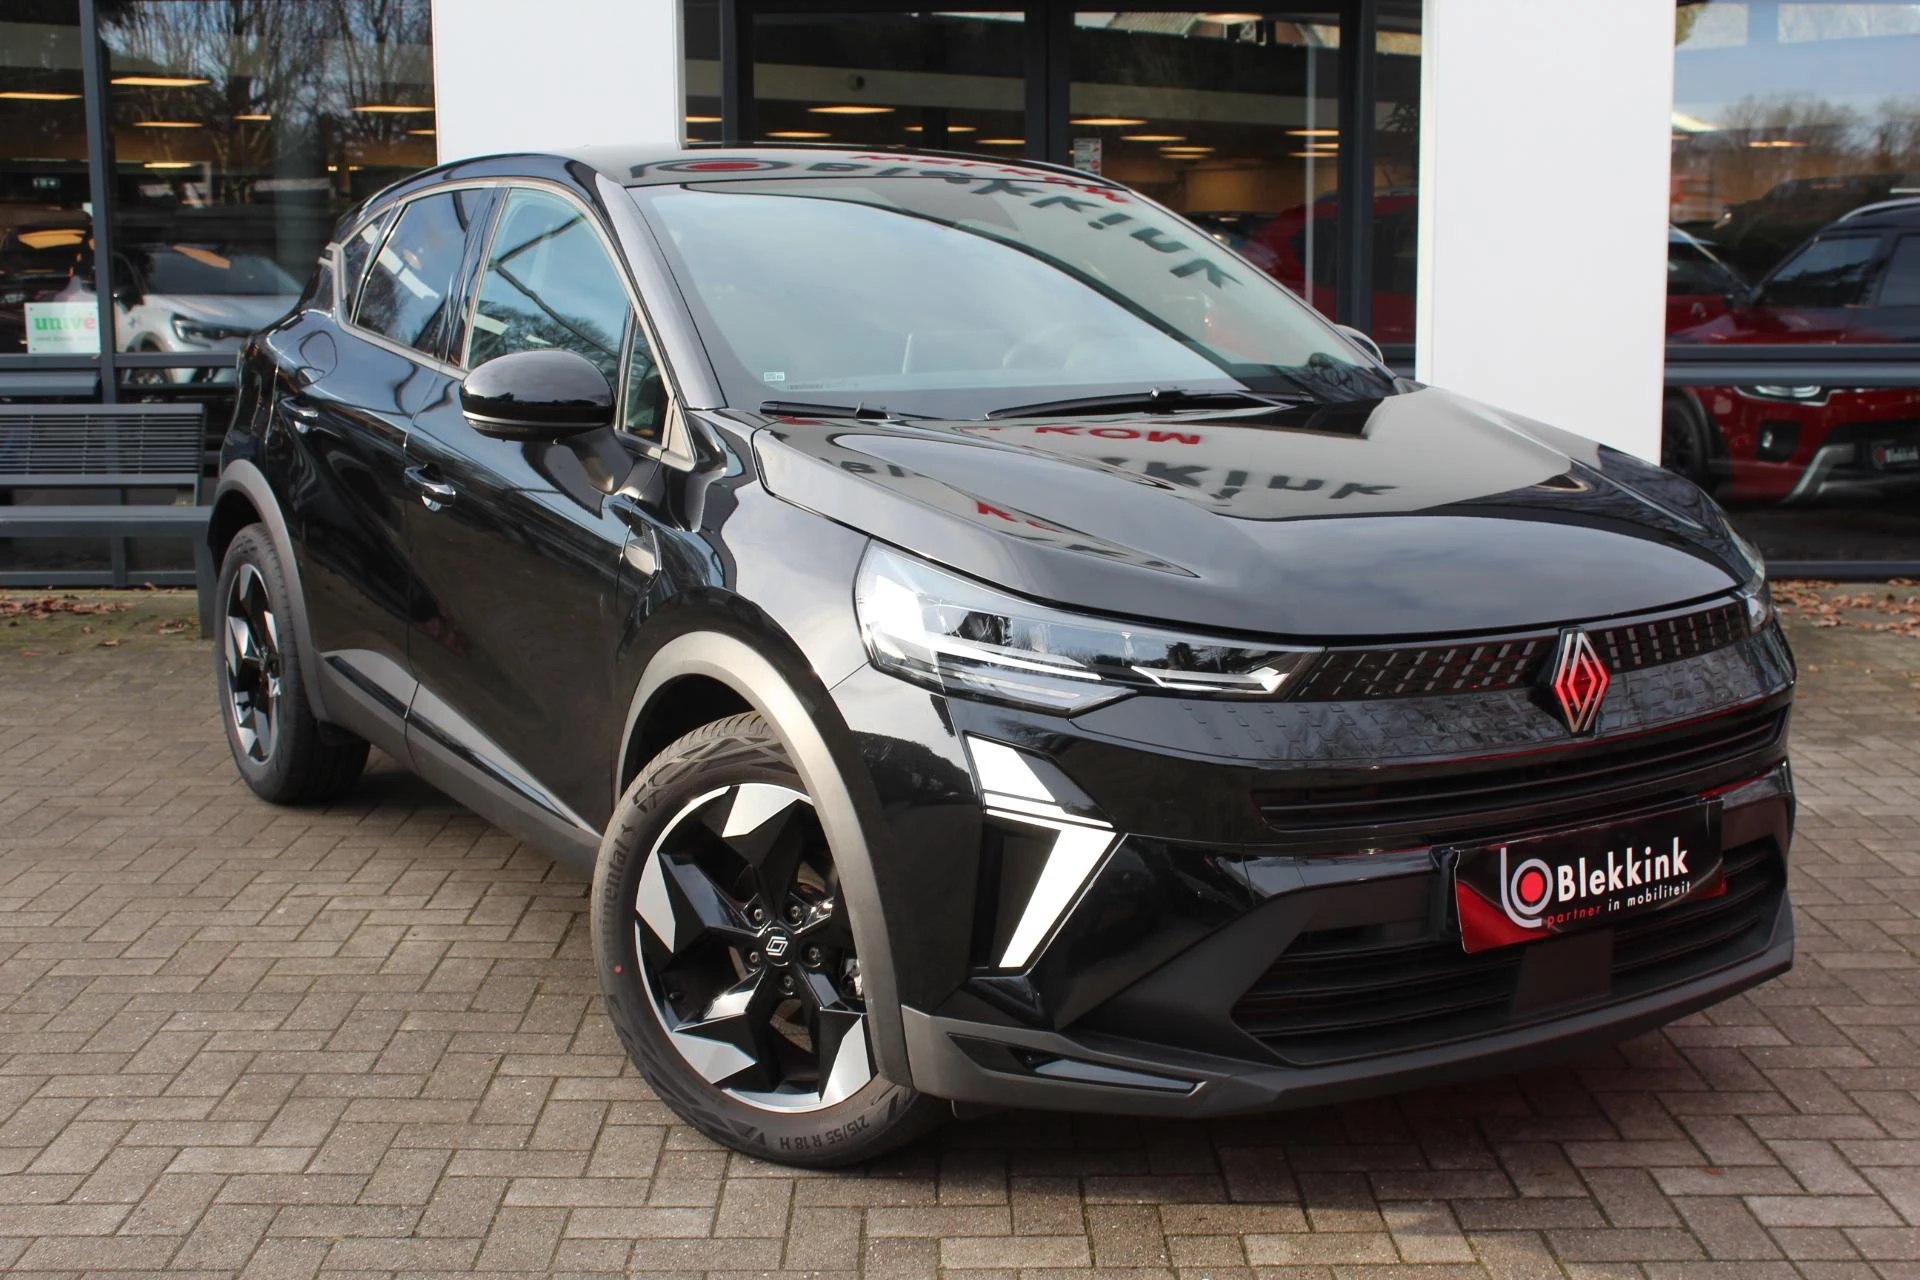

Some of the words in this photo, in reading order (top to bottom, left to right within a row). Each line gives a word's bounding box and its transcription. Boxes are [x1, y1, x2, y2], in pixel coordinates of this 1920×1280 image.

[1557, 837, 1689, 903] Blekkink
[1547, 905, 1602, 928] partner
[1608, 898, 1620, 912] in
[1627, 881, 1691, 908] mobiliteit
[794, 1135, 810, 1149] 18
[811, 1134, 822, 1147] R
[825, 1115, 870, 1145] 215/55
